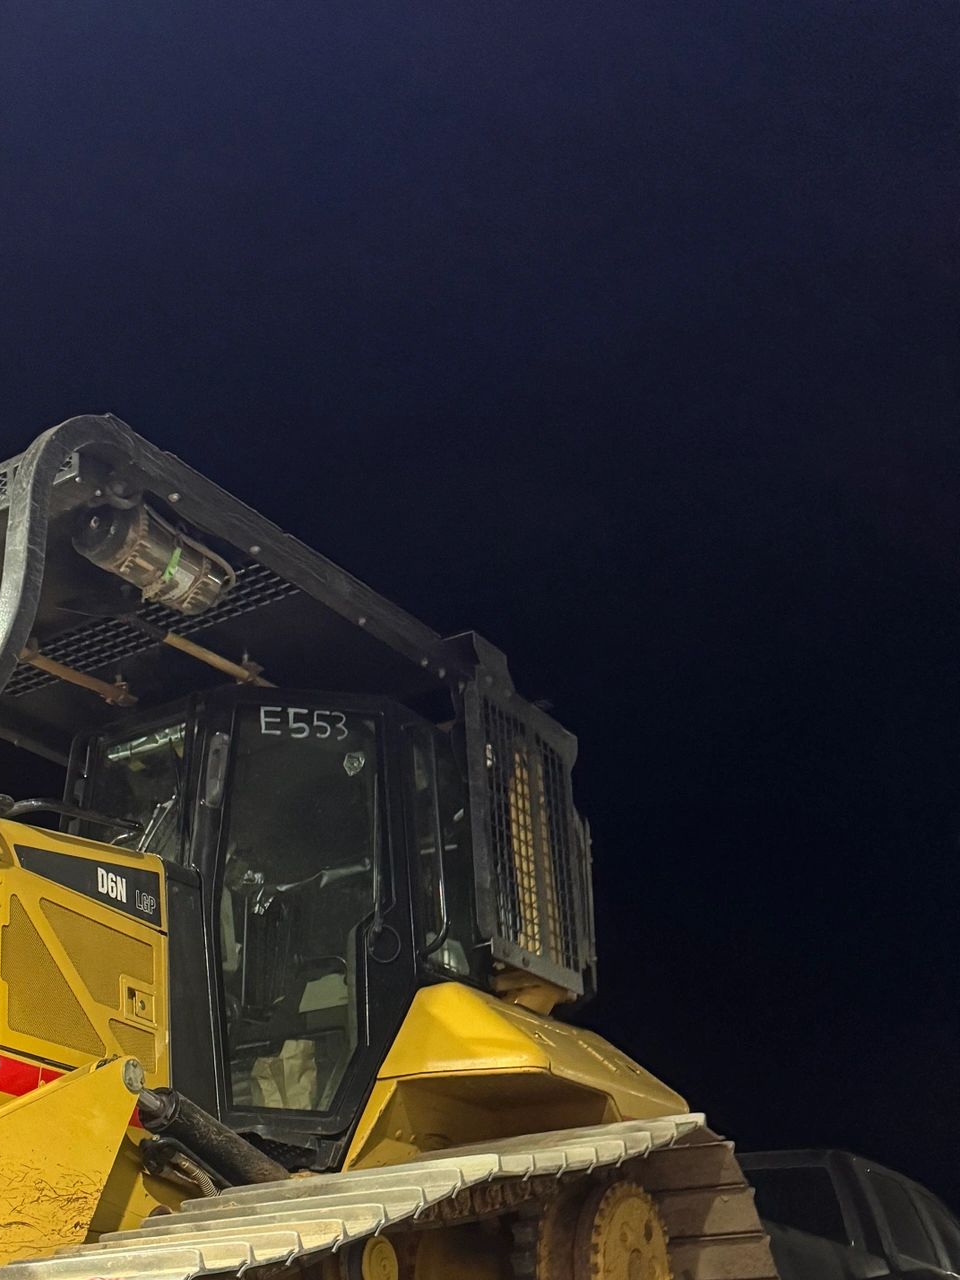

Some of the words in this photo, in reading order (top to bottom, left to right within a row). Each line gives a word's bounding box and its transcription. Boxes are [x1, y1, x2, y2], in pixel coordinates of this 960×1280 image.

[260, 706, 349, 741] E553
[97, 867, 127, 903] D6N
[136, 889, 157, 915] LGP
